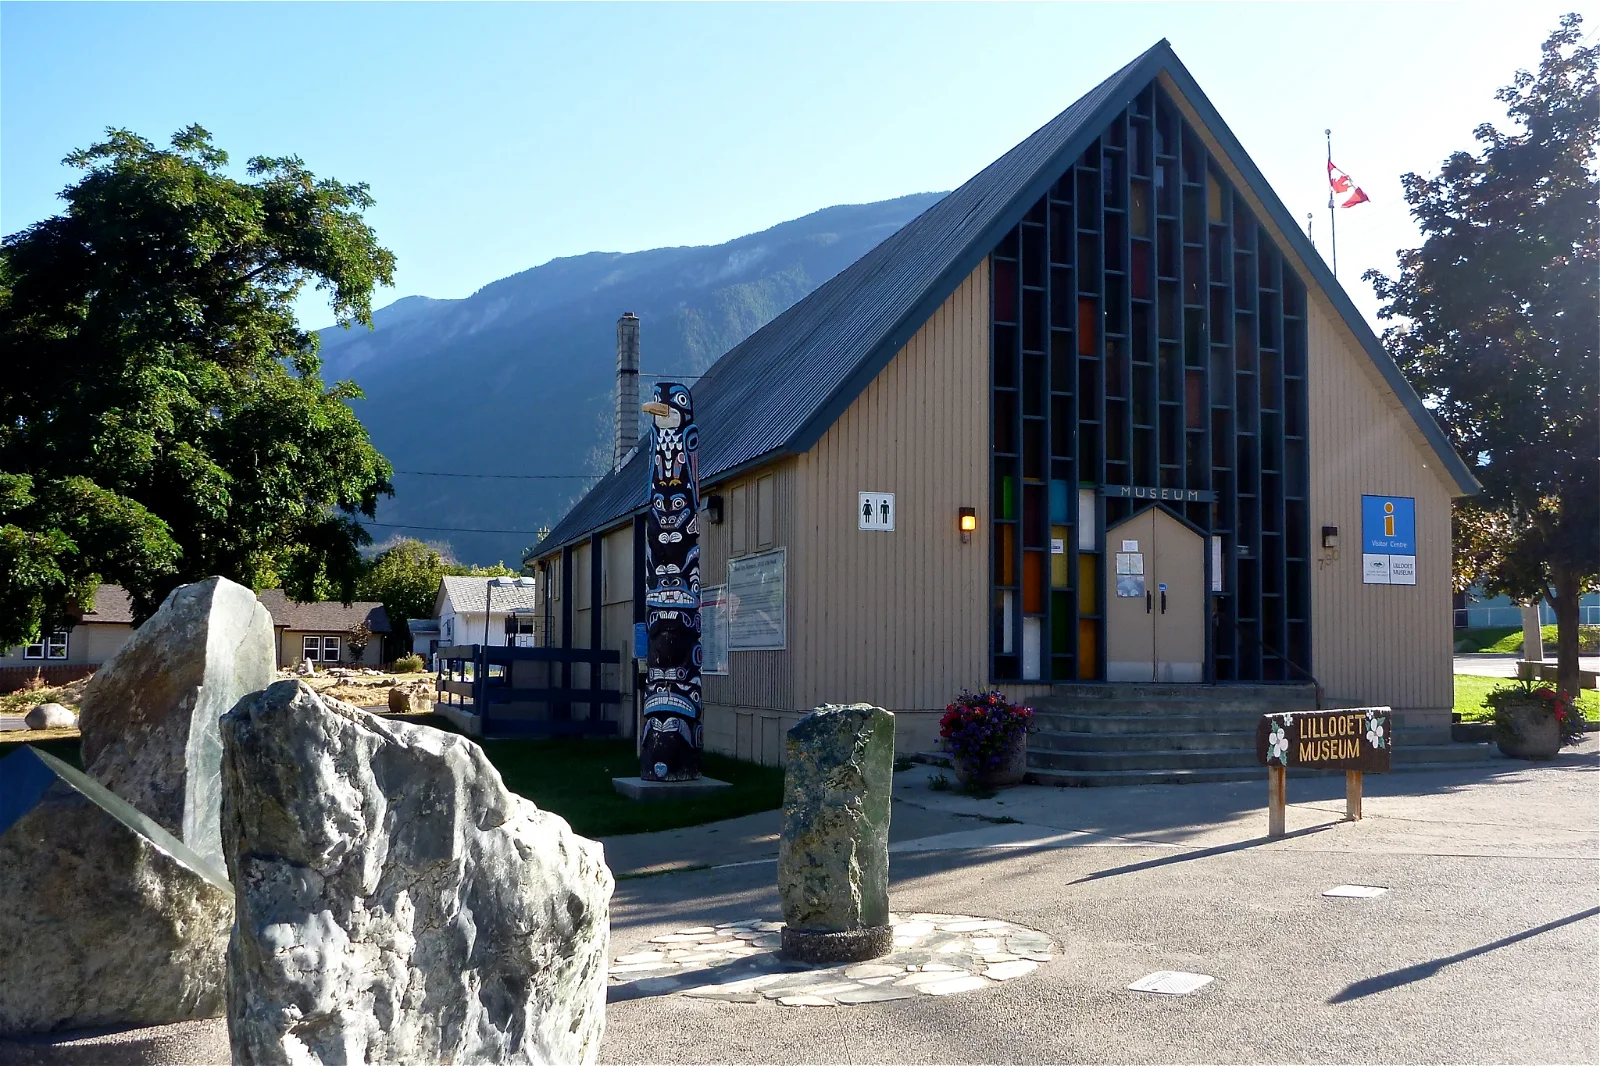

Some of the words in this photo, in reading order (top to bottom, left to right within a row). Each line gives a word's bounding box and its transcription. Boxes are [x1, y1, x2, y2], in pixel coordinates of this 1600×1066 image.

[1121, 486, 1198, 501] MUSEUM
[1389, 540, 1408, 548] Centre
[1300, 714, 1366, 739] LILLOOET
[1299, 738, 1360, 762] MUSEUM
